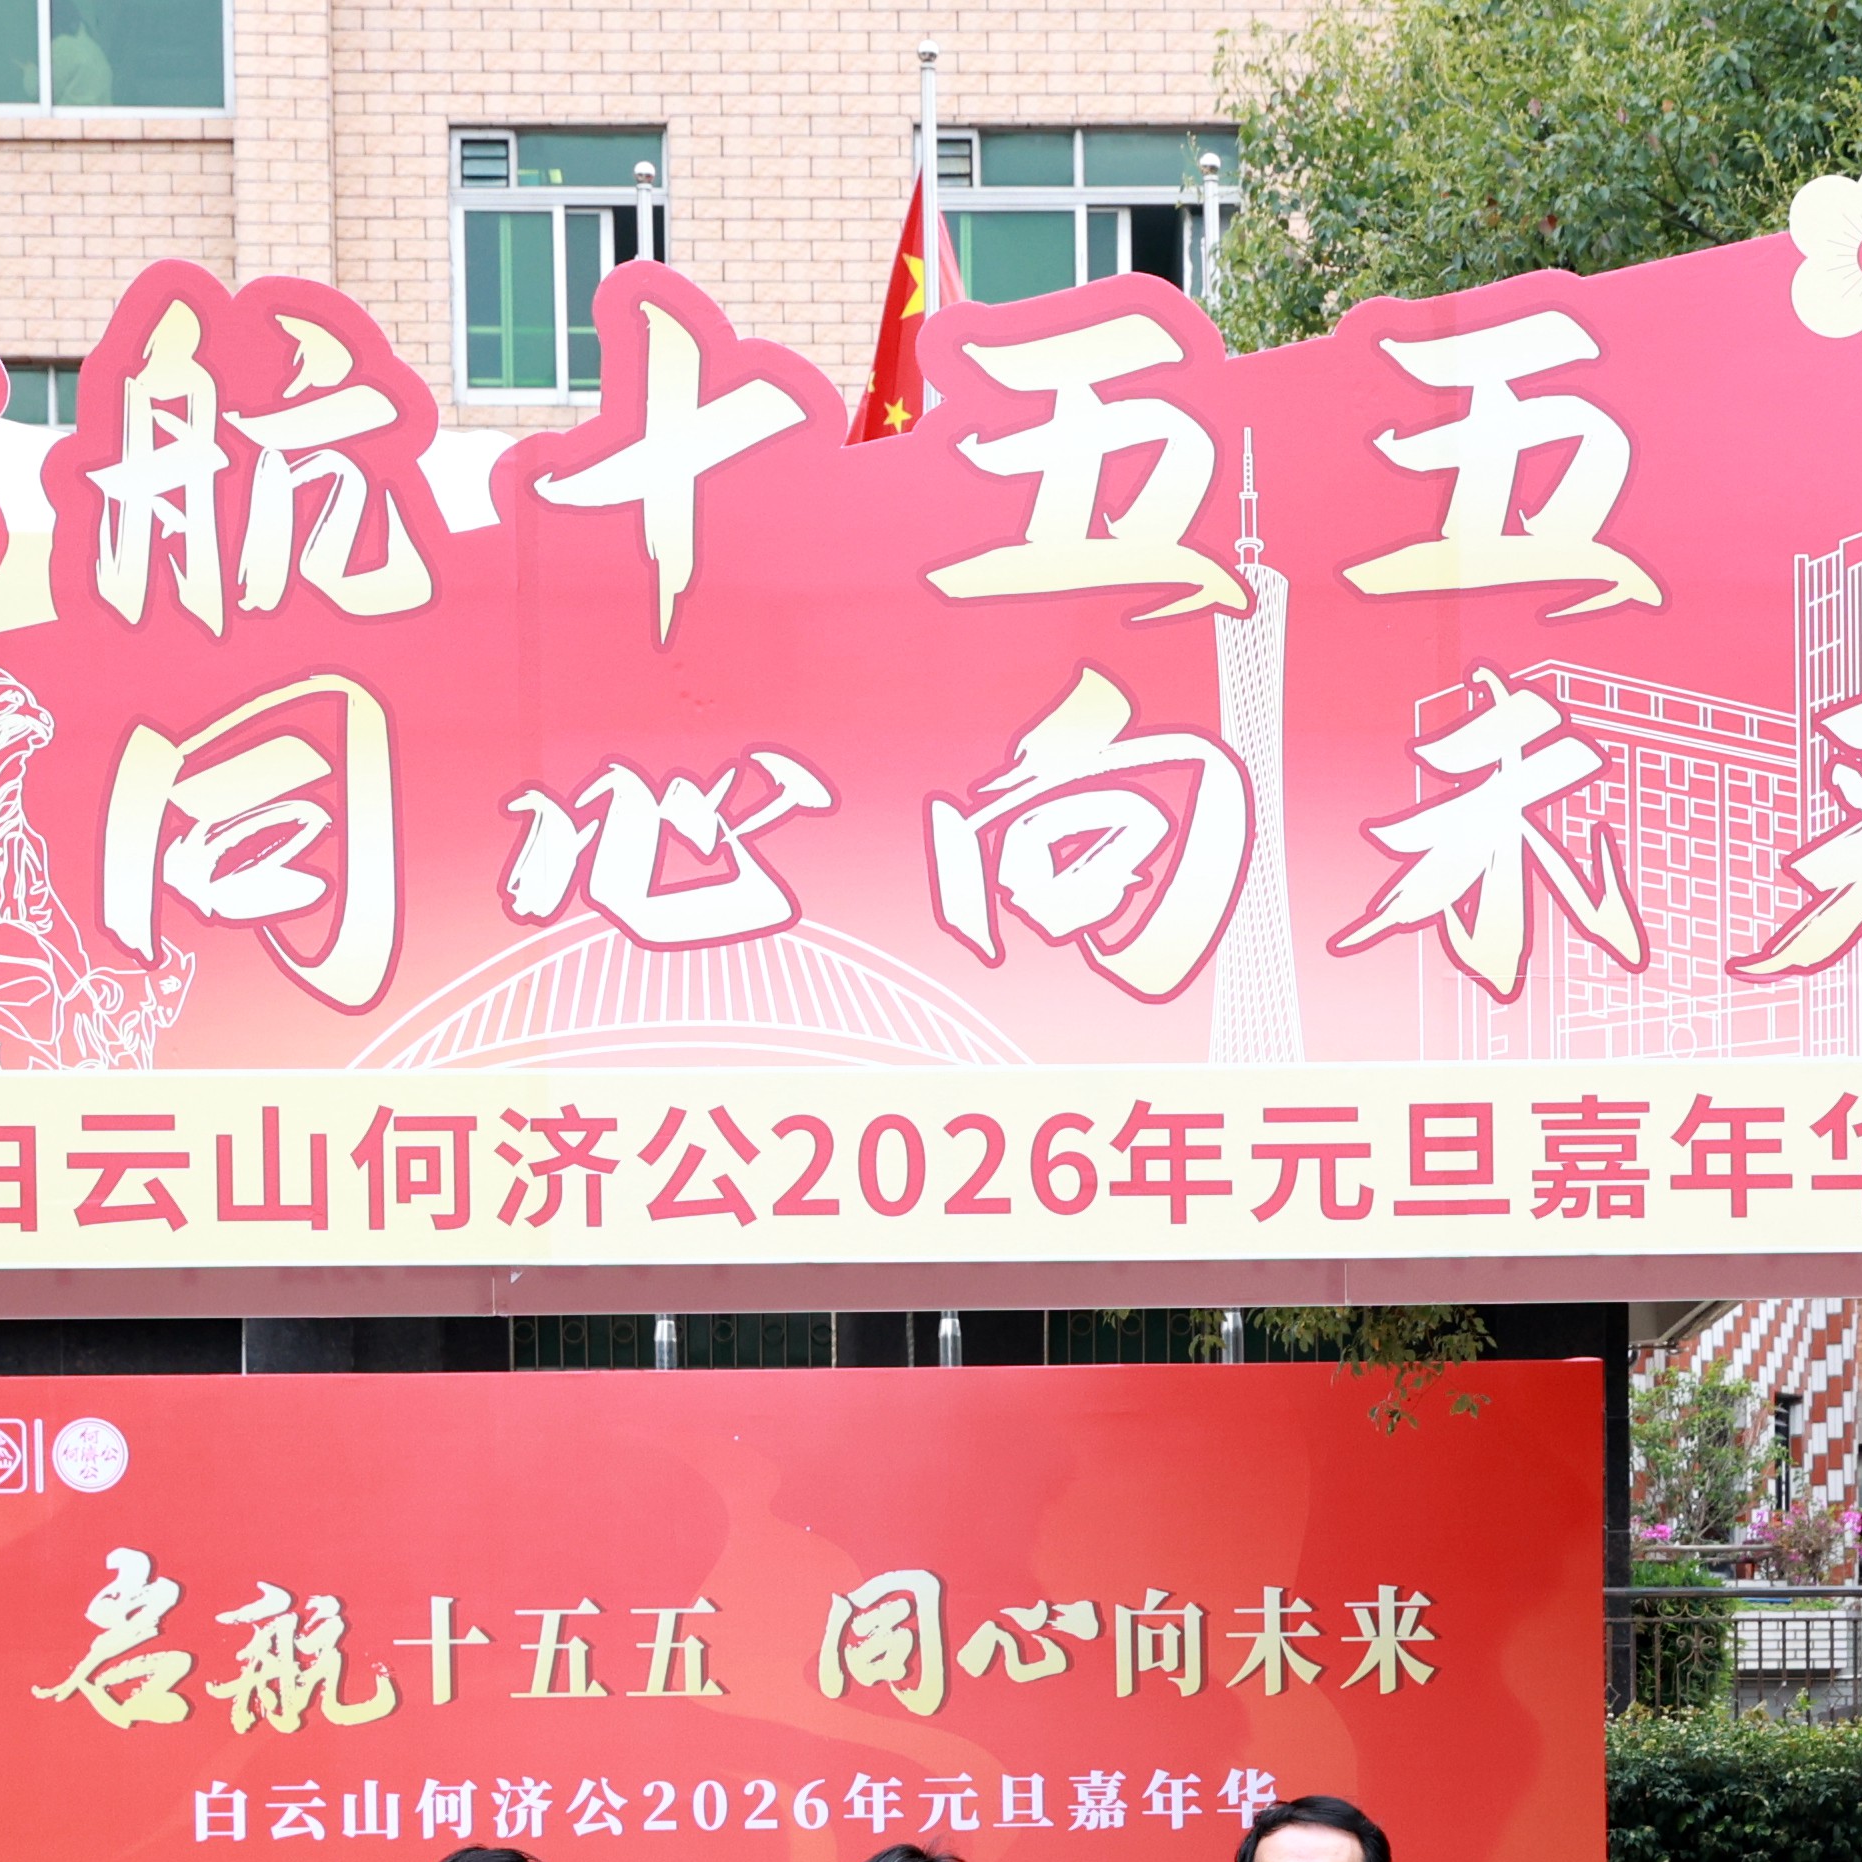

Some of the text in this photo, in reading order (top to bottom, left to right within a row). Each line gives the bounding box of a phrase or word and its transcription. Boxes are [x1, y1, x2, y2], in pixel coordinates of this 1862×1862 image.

[32, 1547, 1435, 1735] 启航十五五 同心向未来
[194, 1768, 1277, 1842] 白云山何济公2026年元旦嘉年华
